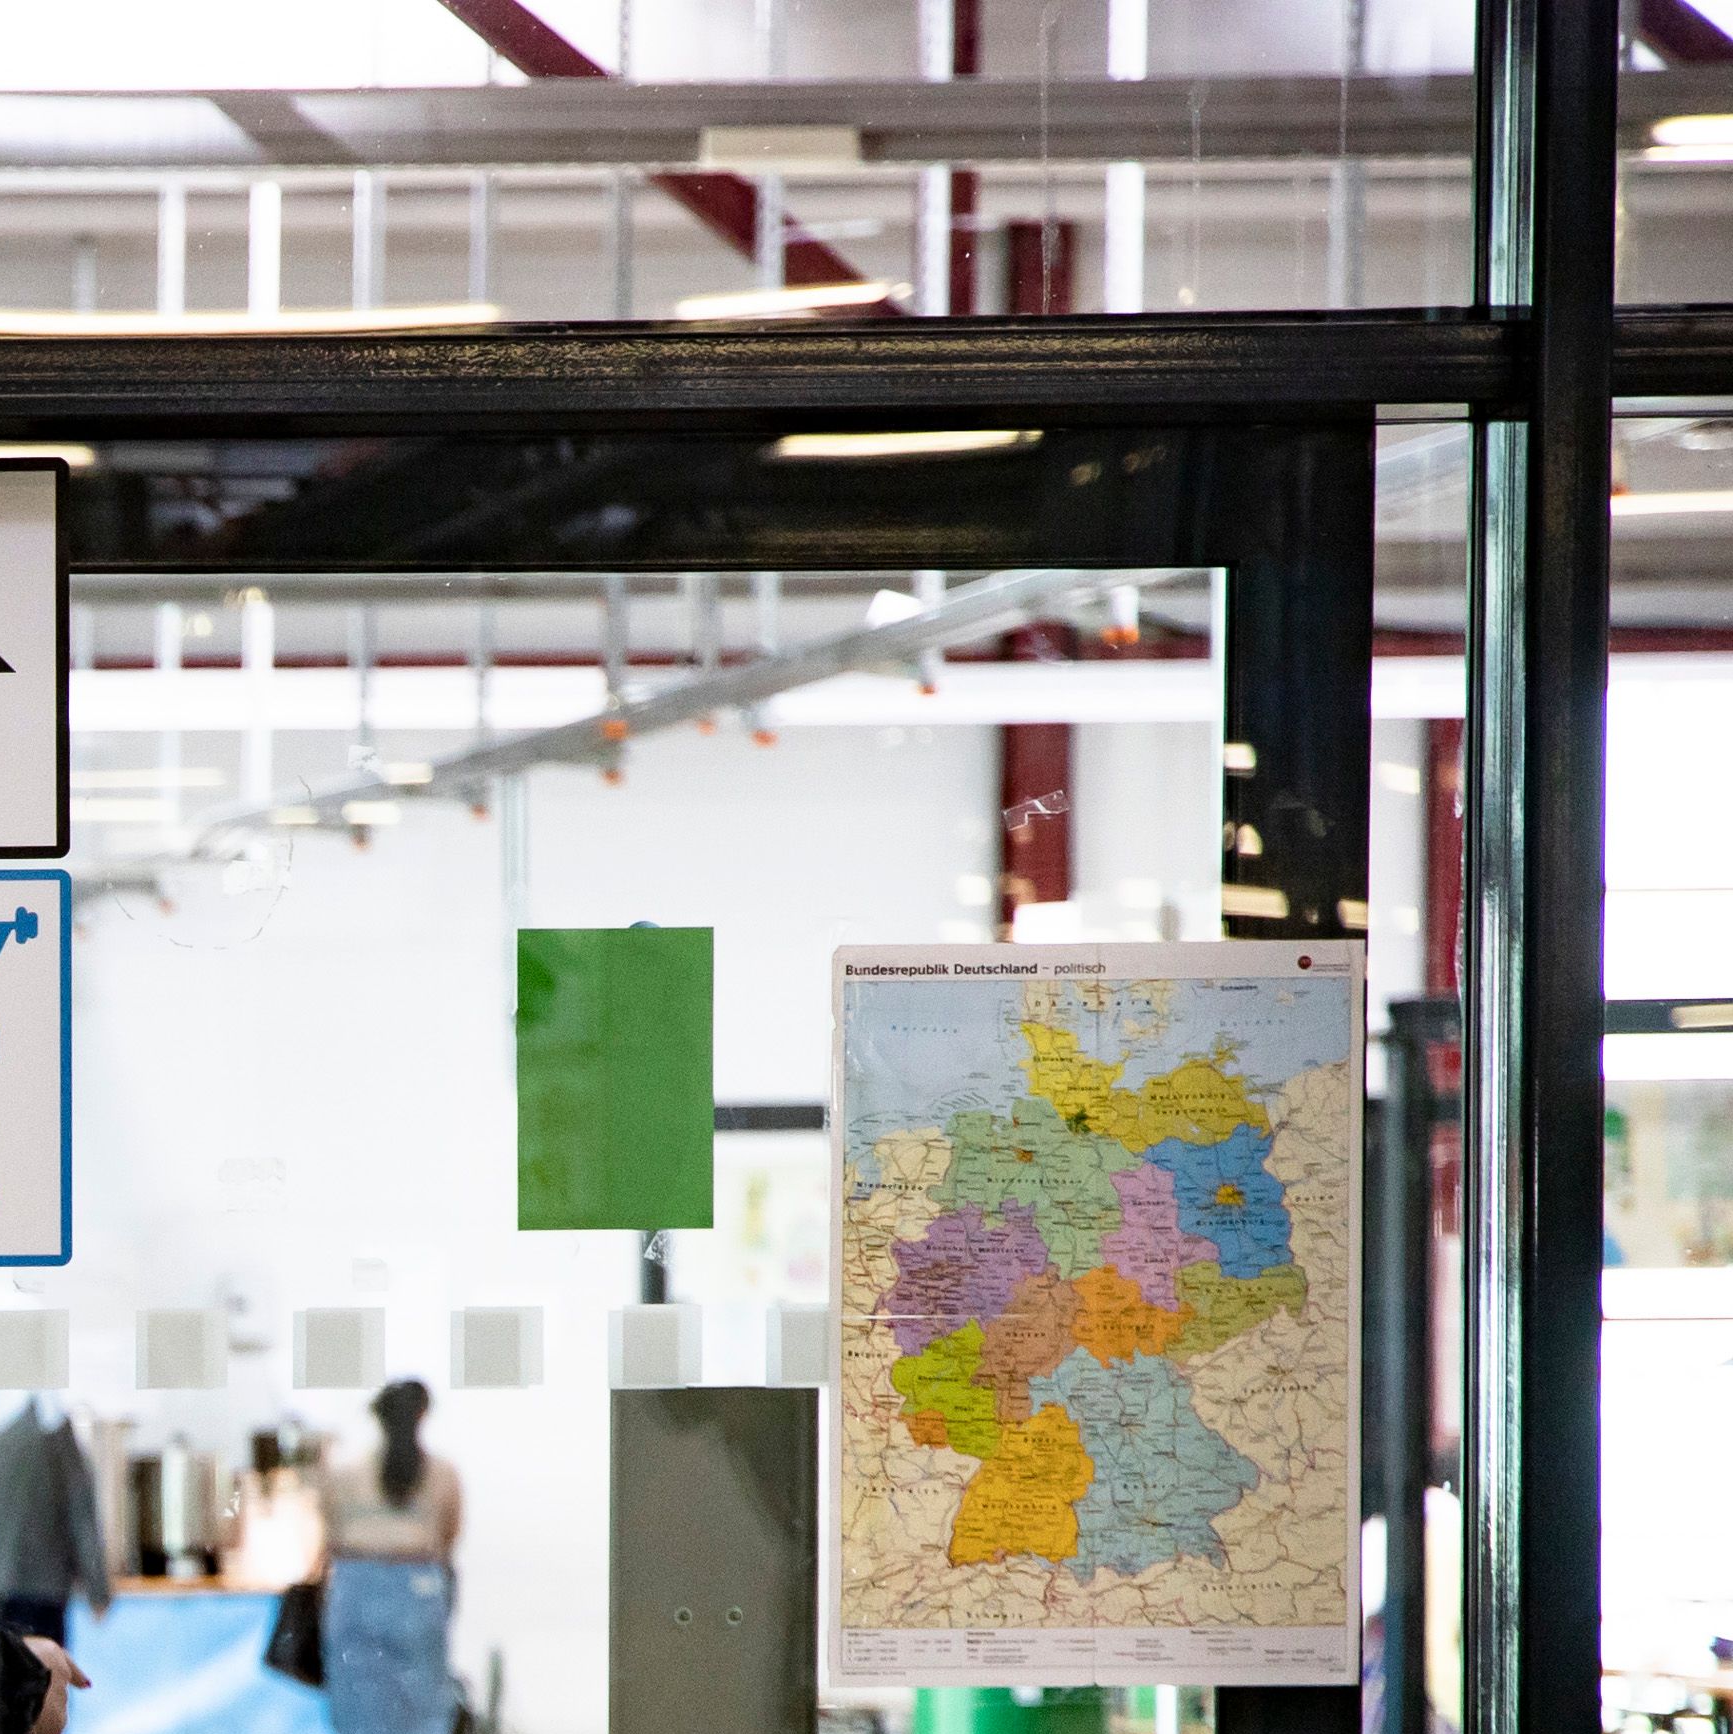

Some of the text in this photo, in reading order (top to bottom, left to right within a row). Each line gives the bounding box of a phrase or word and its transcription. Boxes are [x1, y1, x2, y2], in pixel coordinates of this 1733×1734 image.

[845, 964, 949, 977] Bundesrepublik
[953, 963, 1038, 975] Deutschland
[1054, 962, 1107, 976] politisch
